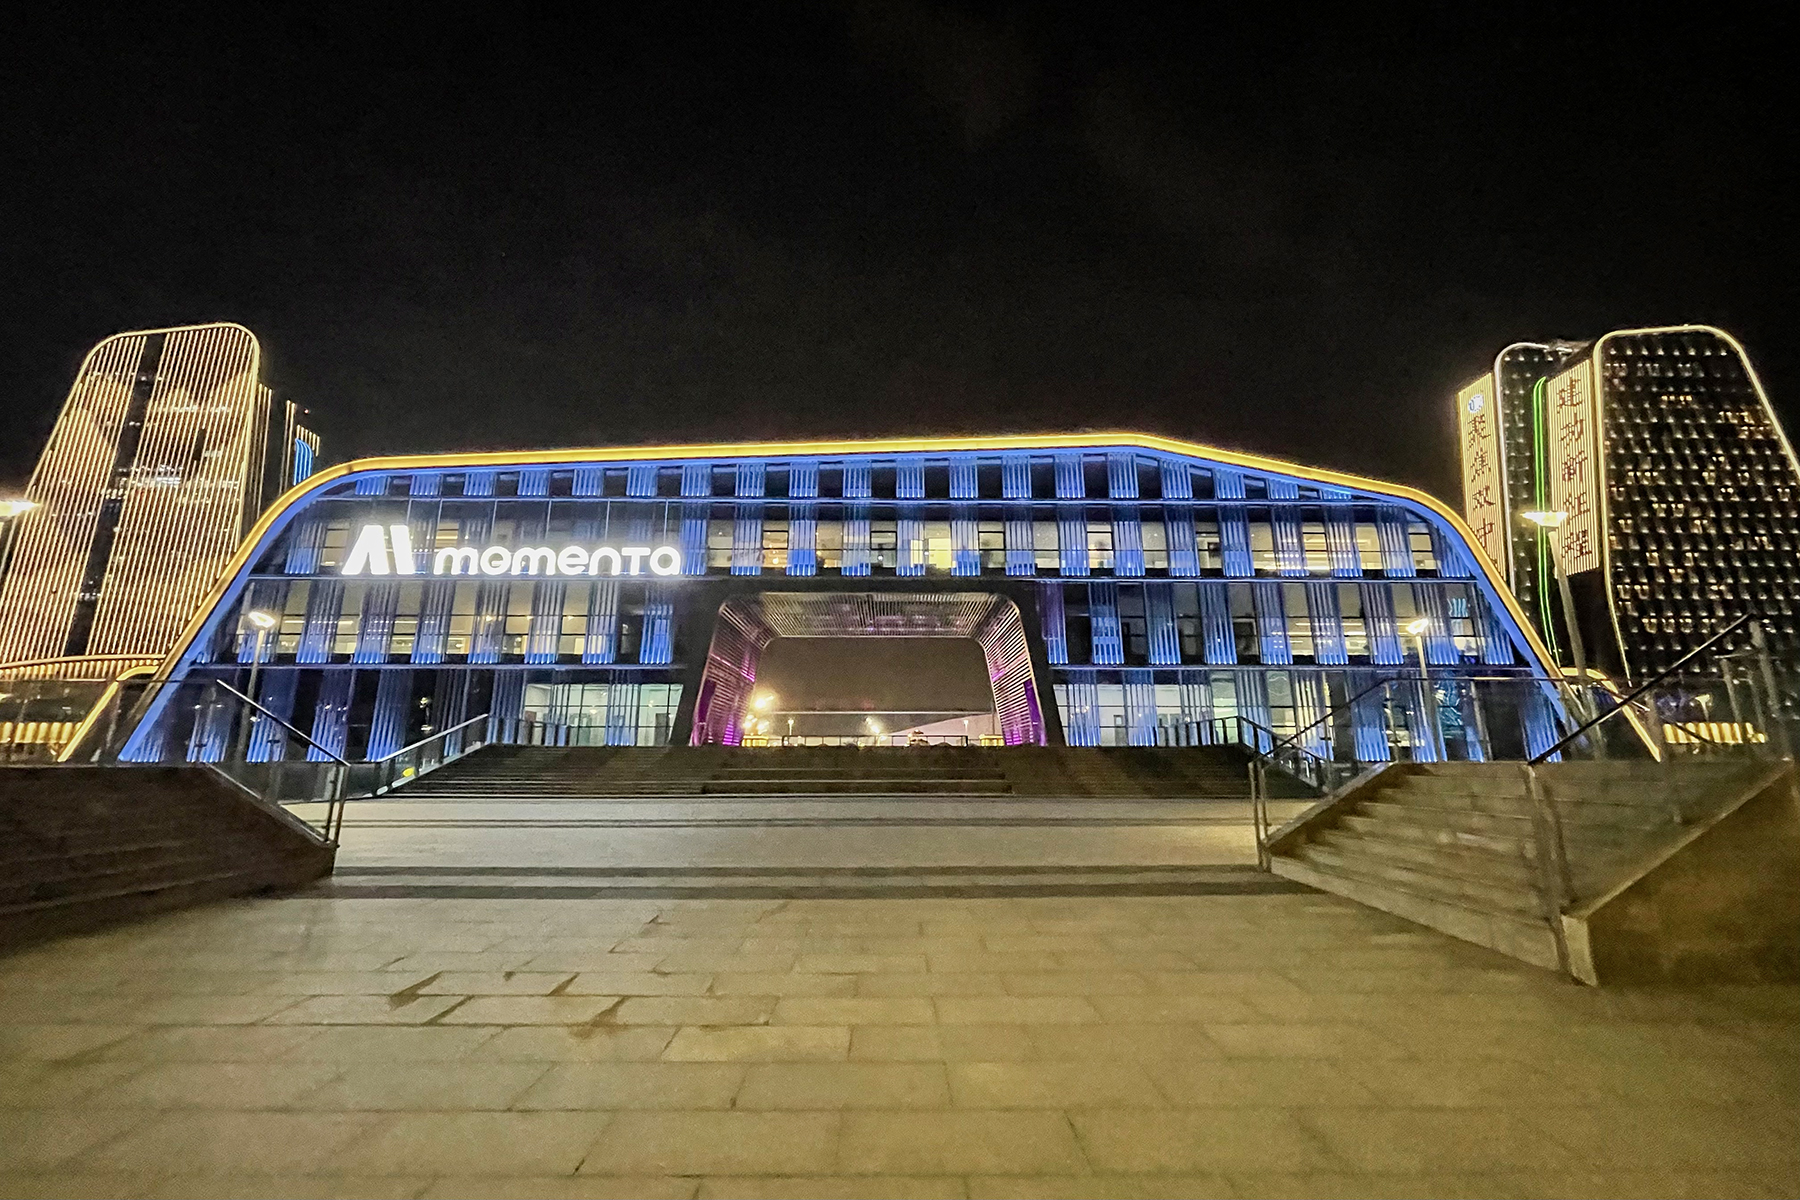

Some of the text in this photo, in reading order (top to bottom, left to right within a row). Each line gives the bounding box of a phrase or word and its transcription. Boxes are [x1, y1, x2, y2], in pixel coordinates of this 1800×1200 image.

[1467, 414, 1498, 566] 聚焦双中
[1556, 377, 1592, 560] 建功新征程
[433, 545, 682, 576] momenta
